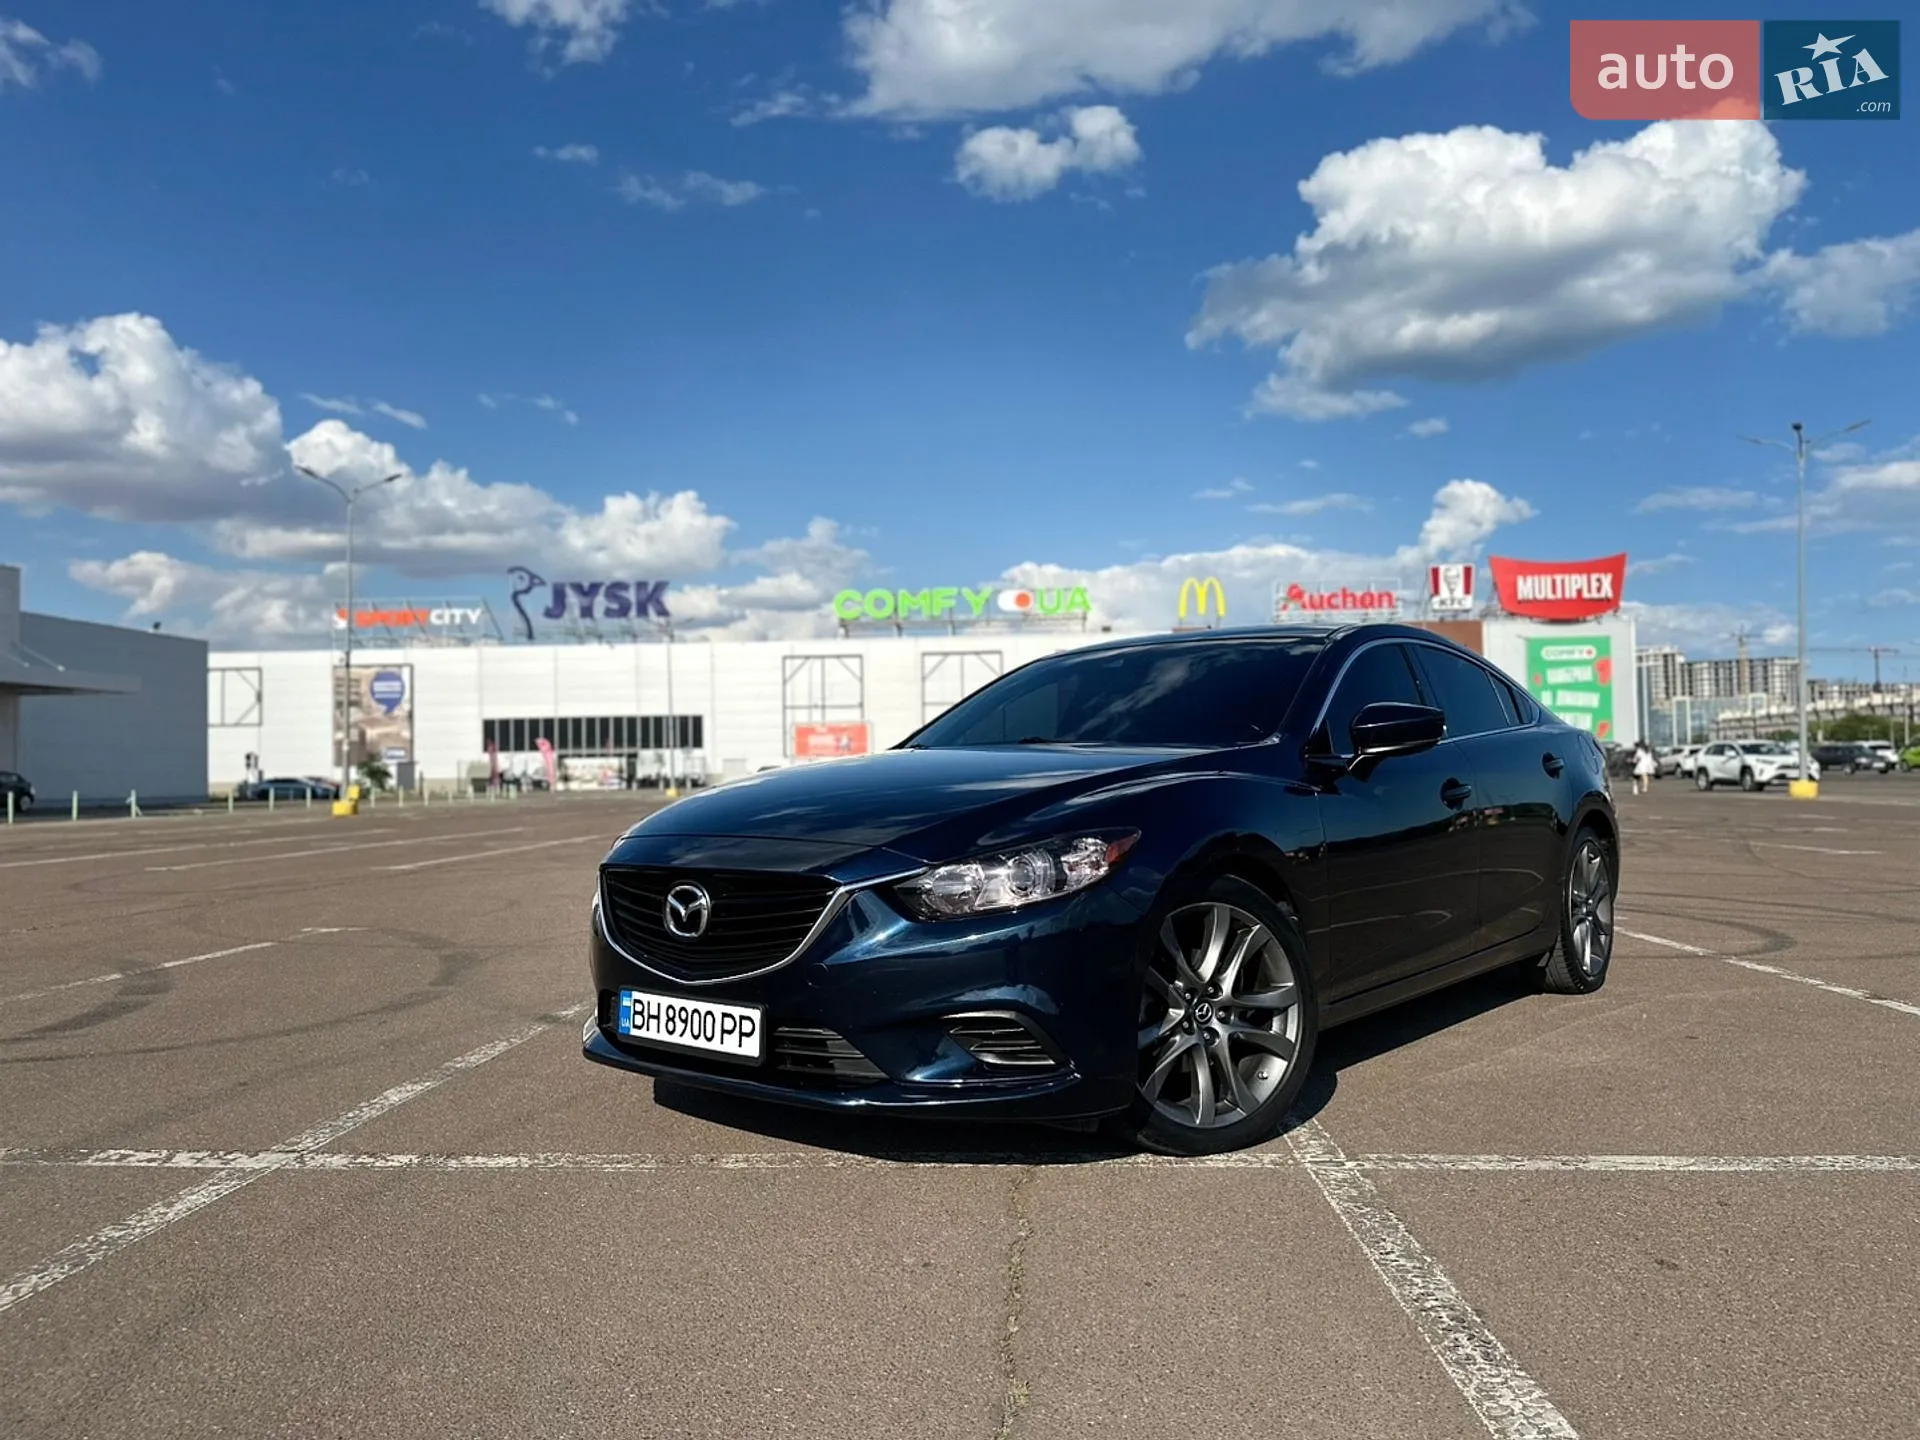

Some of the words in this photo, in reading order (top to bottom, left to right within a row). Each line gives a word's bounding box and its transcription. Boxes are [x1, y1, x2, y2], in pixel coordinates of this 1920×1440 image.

[543, 579, 671, 620] JYSK
[833, 587, 993, 620] COMFY
[1037, 586, 1091, 615] UA
[1280, 582, 1396, 611] Auchan
[1516, 572, 1614, 603] MULTIPLEX
[631, 998, 661, 1034] BH
[665, 1003, 716, 1043] 8900
[720, 1012, 757, 1048] PP
